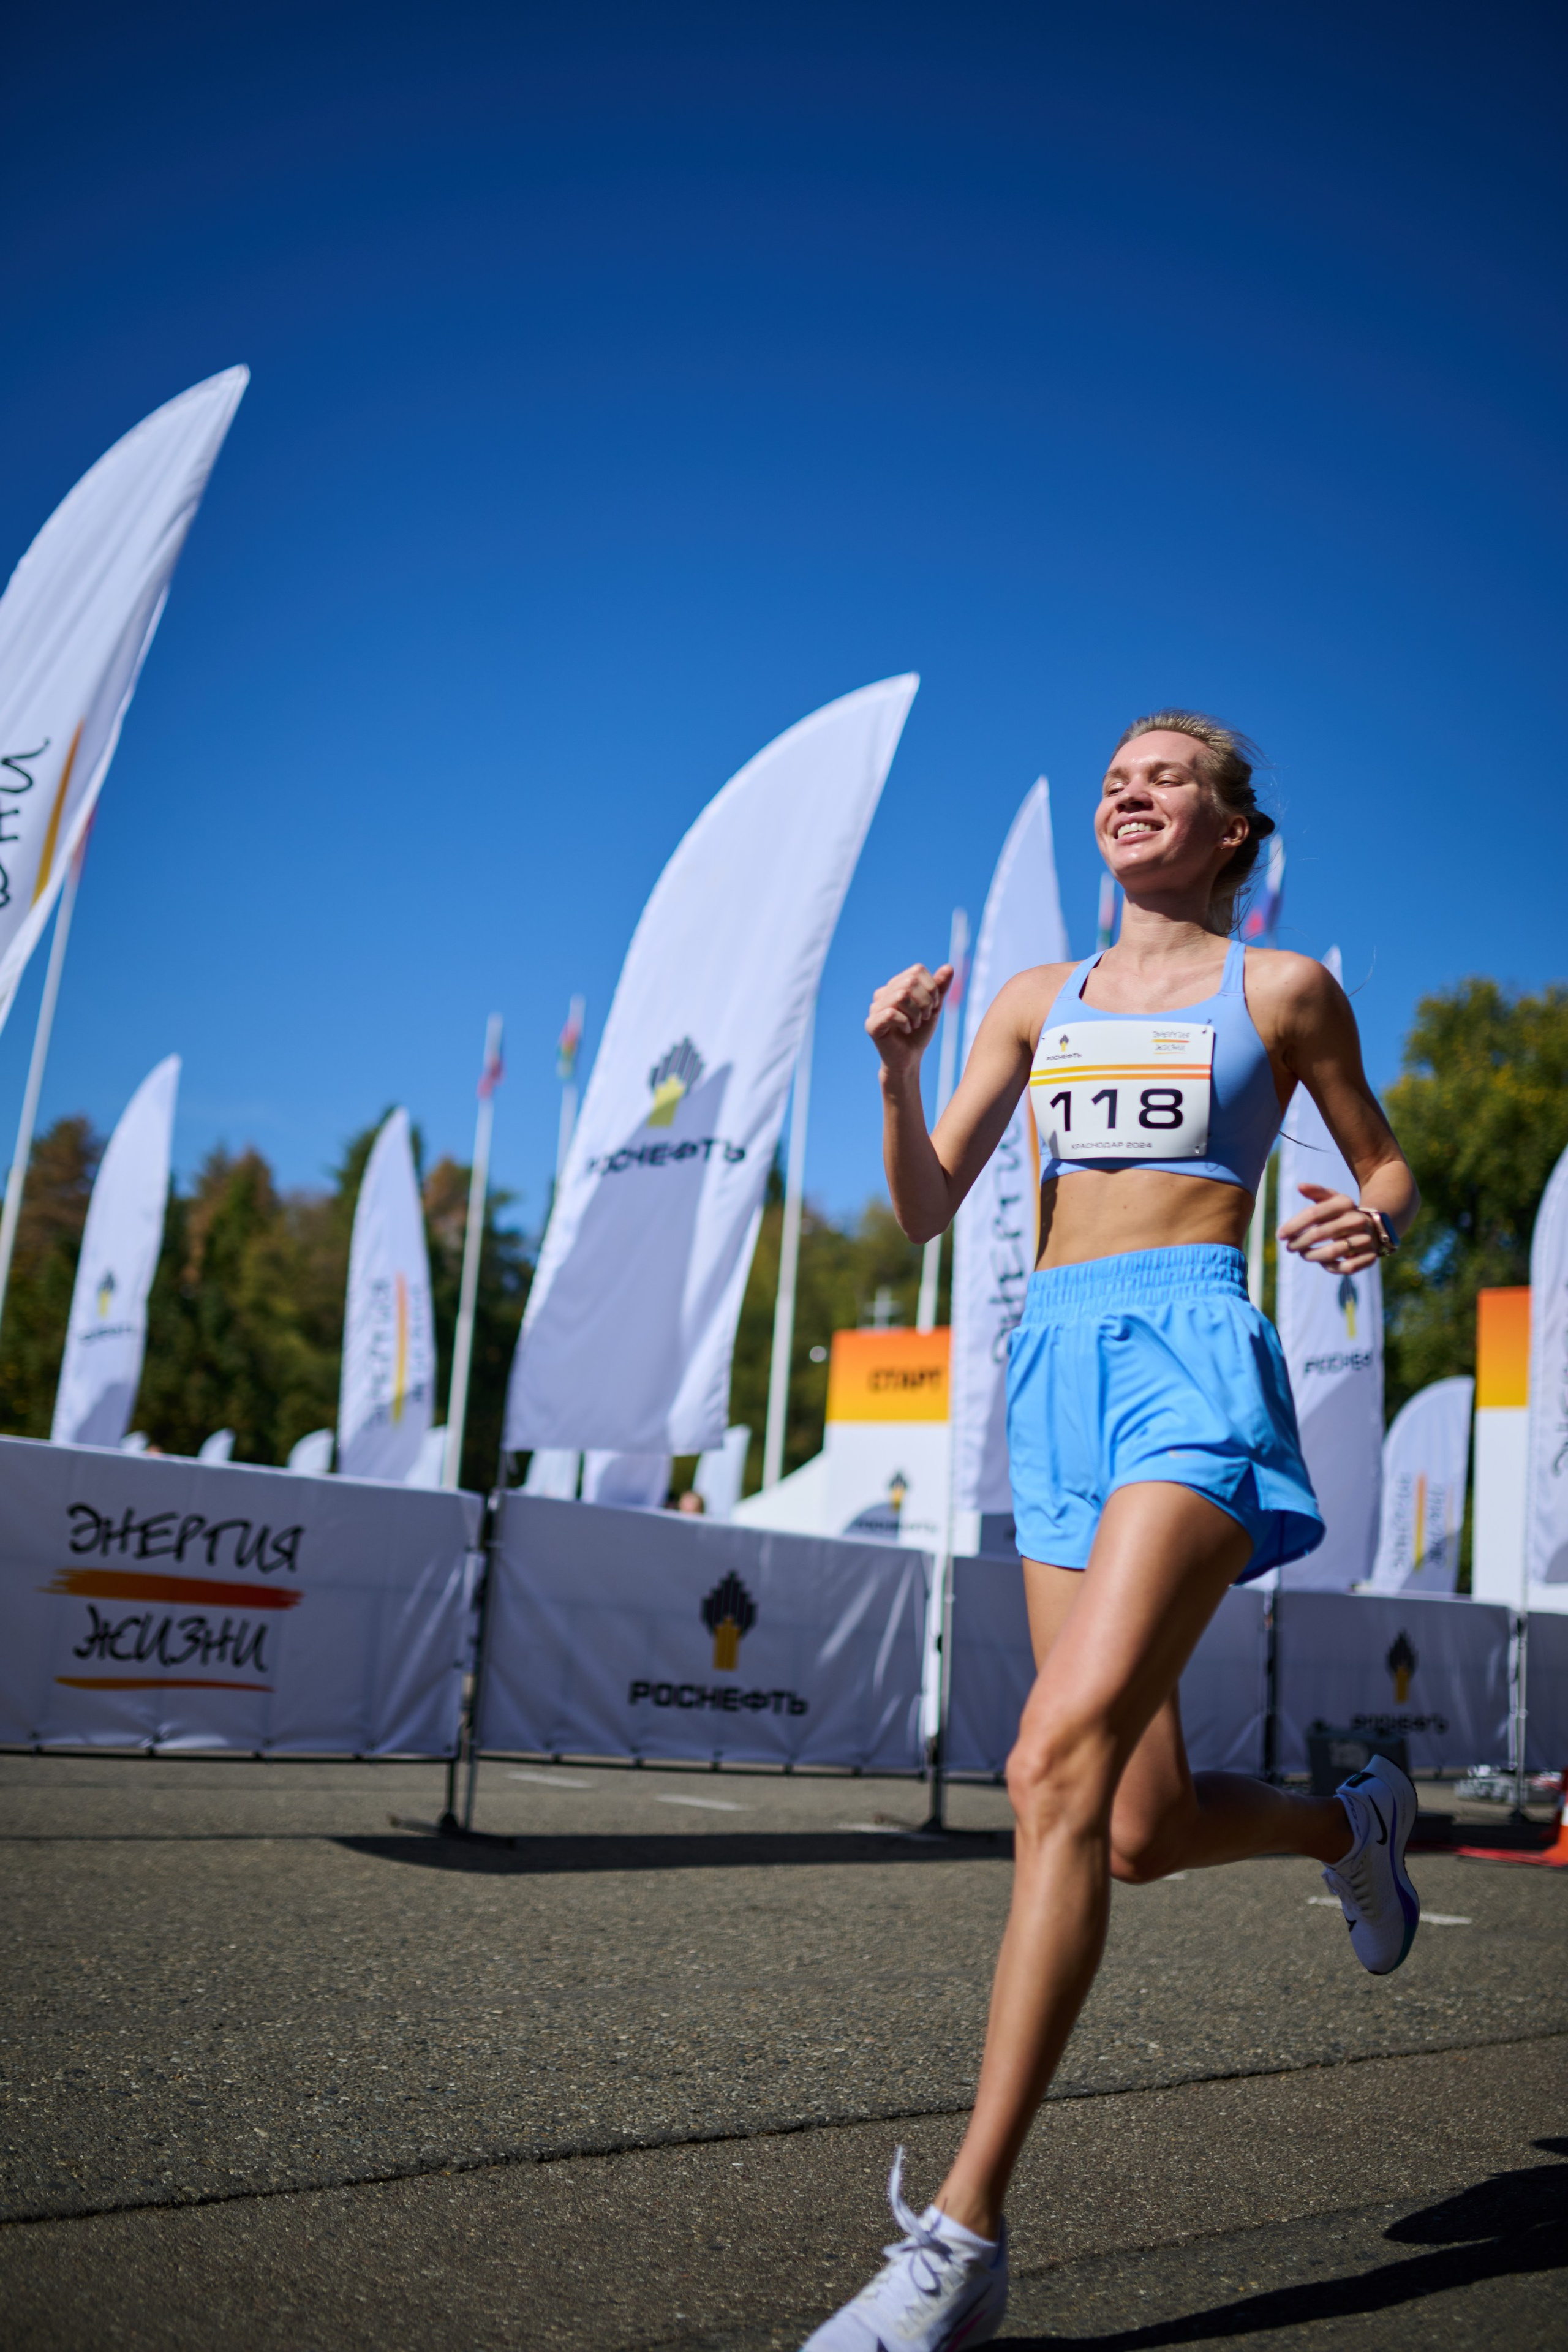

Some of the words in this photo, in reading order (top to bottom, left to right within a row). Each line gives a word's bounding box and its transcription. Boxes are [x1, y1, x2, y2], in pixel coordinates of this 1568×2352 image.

[1049, 1088, 1184, 1132] 118
[67, 1502, 306, 1573] ЭНЕРГИЯ
[72, 1603, 269, 1673] ЖИЗНИ
[628, 1680, 809, 1716] РОСНЕФТЬ
